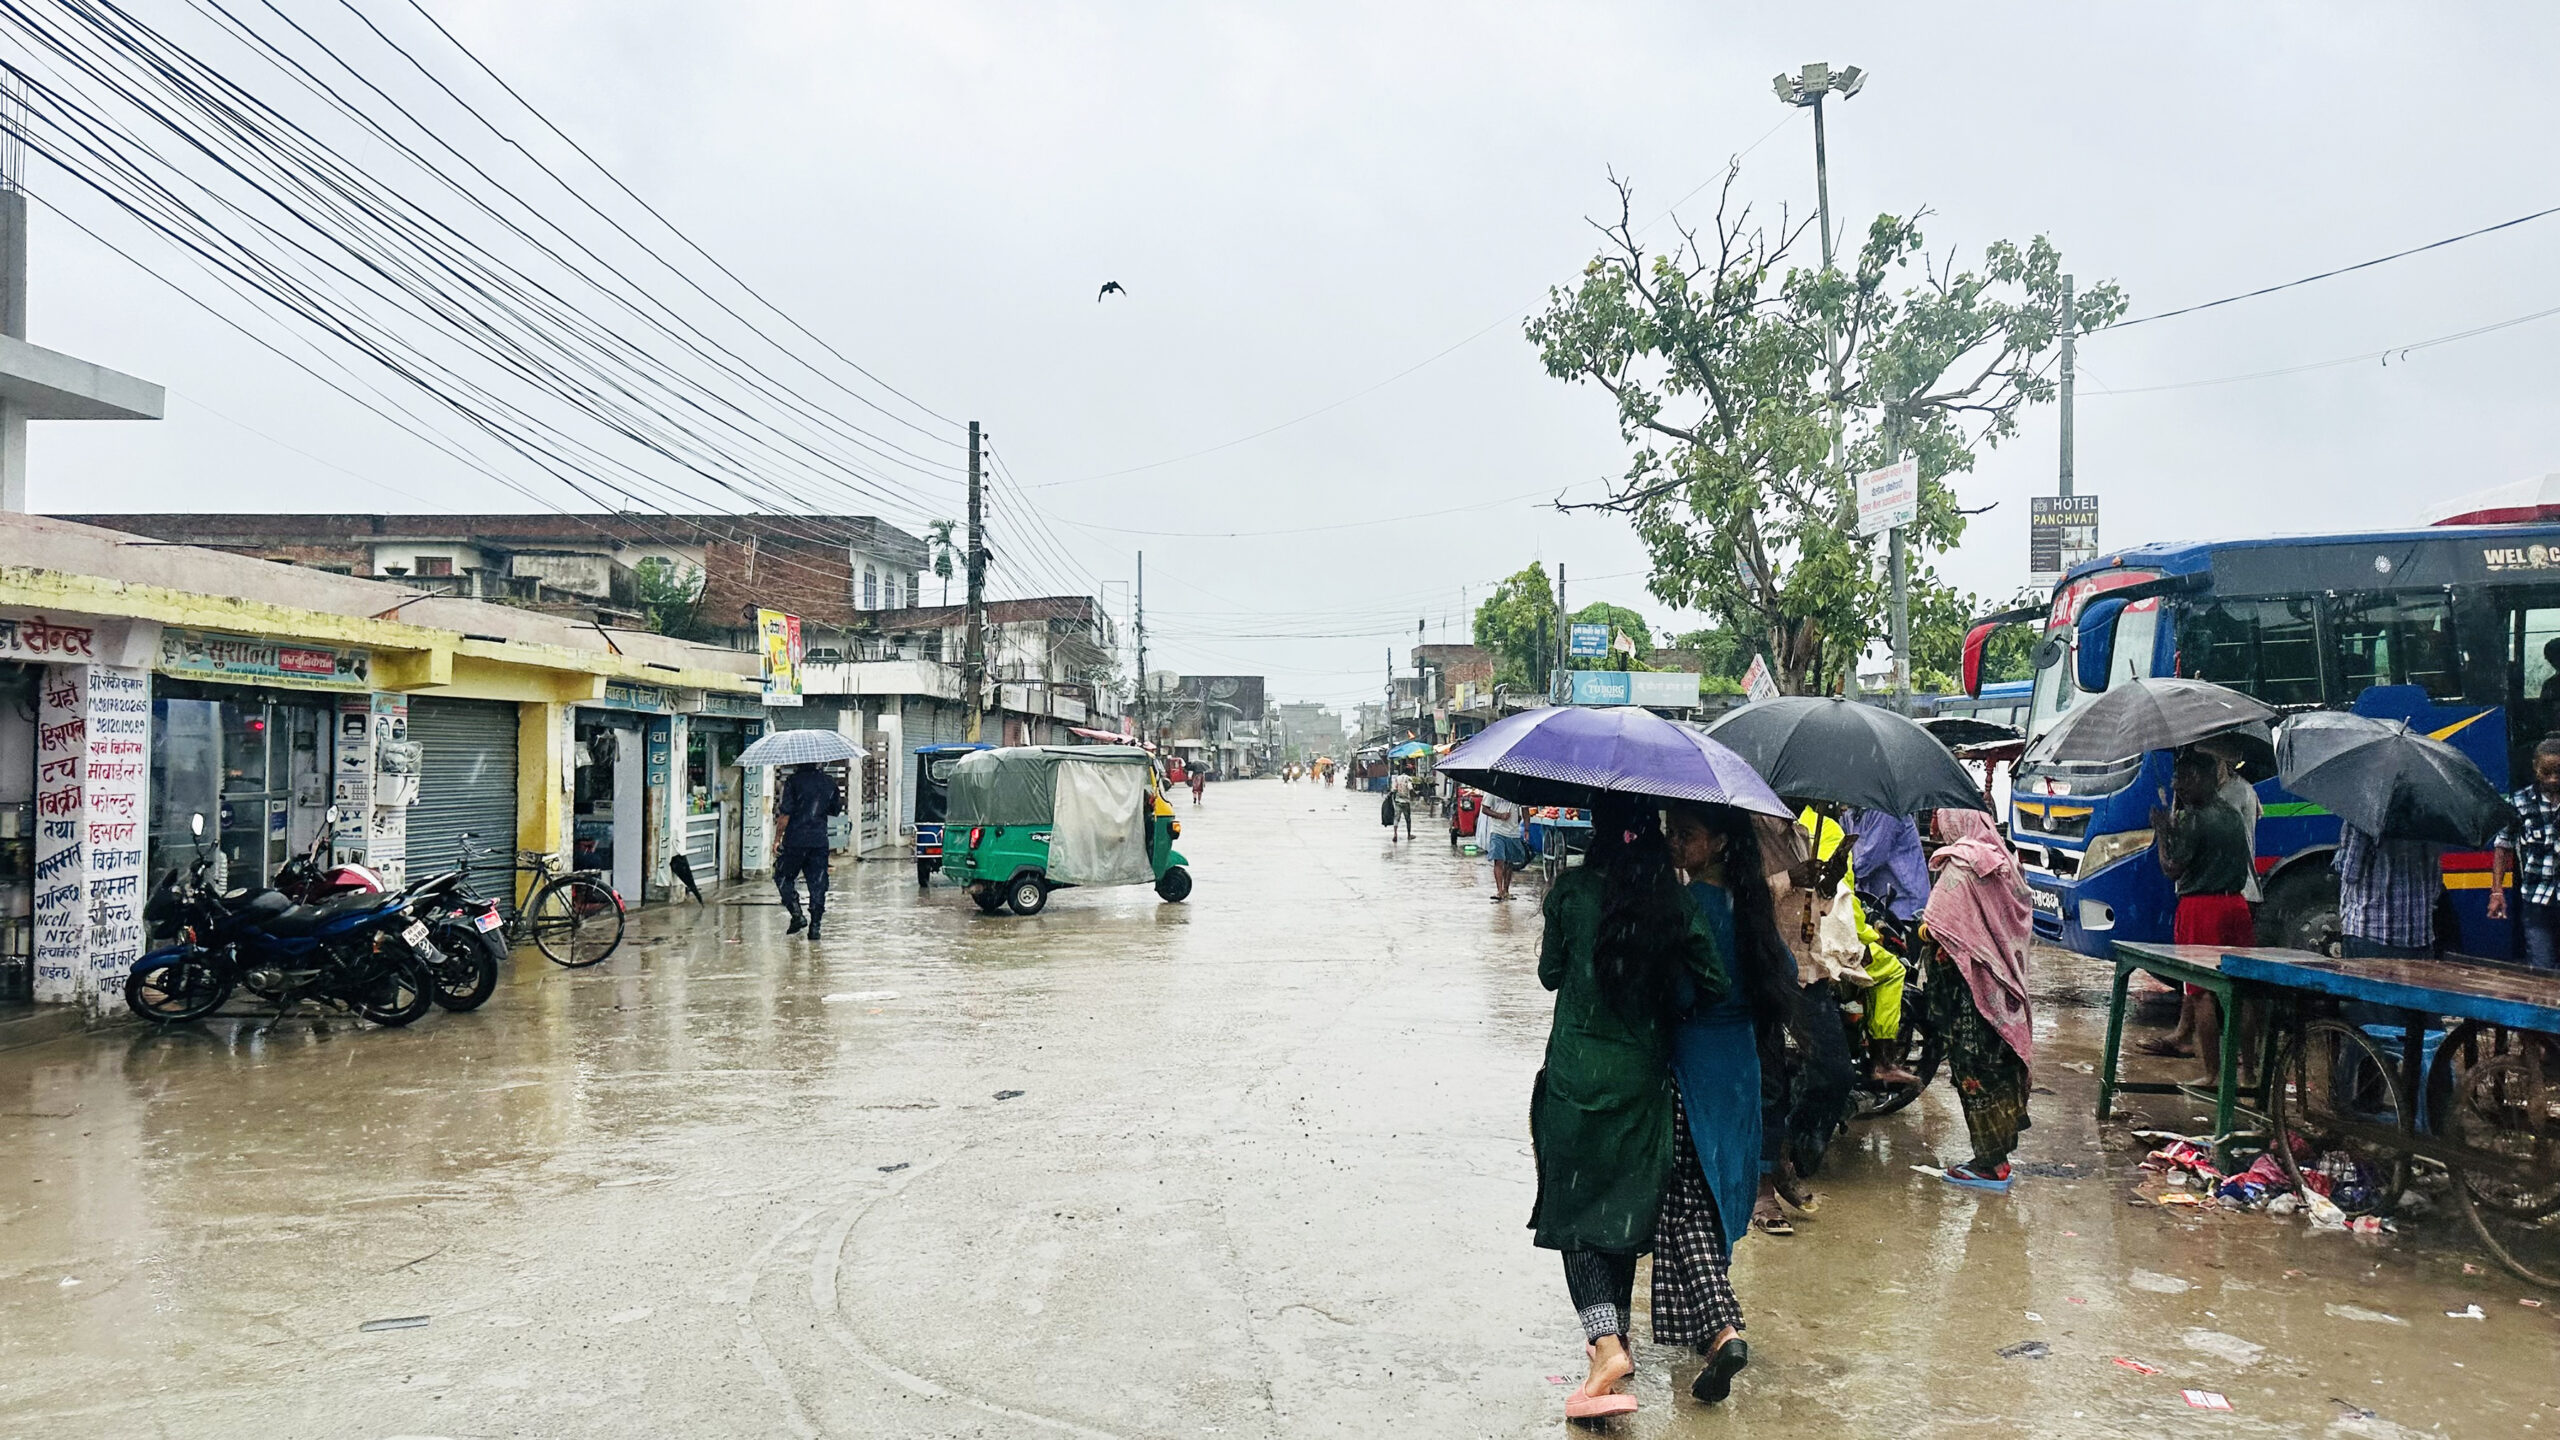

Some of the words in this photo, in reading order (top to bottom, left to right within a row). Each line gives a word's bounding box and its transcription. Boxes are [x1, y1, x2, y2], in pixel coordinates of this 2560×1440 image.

[2053, 498, 2097, 510] HOTEL
[2033, 513, 2098, 525] PANCHVATI
[22, 615, 95, 657] सेन्टर
[204, 639, 276, 670] सुशान्त
[1588, 685, 1624, 694] TUBORG
[41, 756, 80, 783] टच
[38, 784, 84, 817] बिक्री
[43, 820, 76, 840] तथा
[92, 847, 122, 871] बिक्री
[45, 929, 76, 943] NTC
